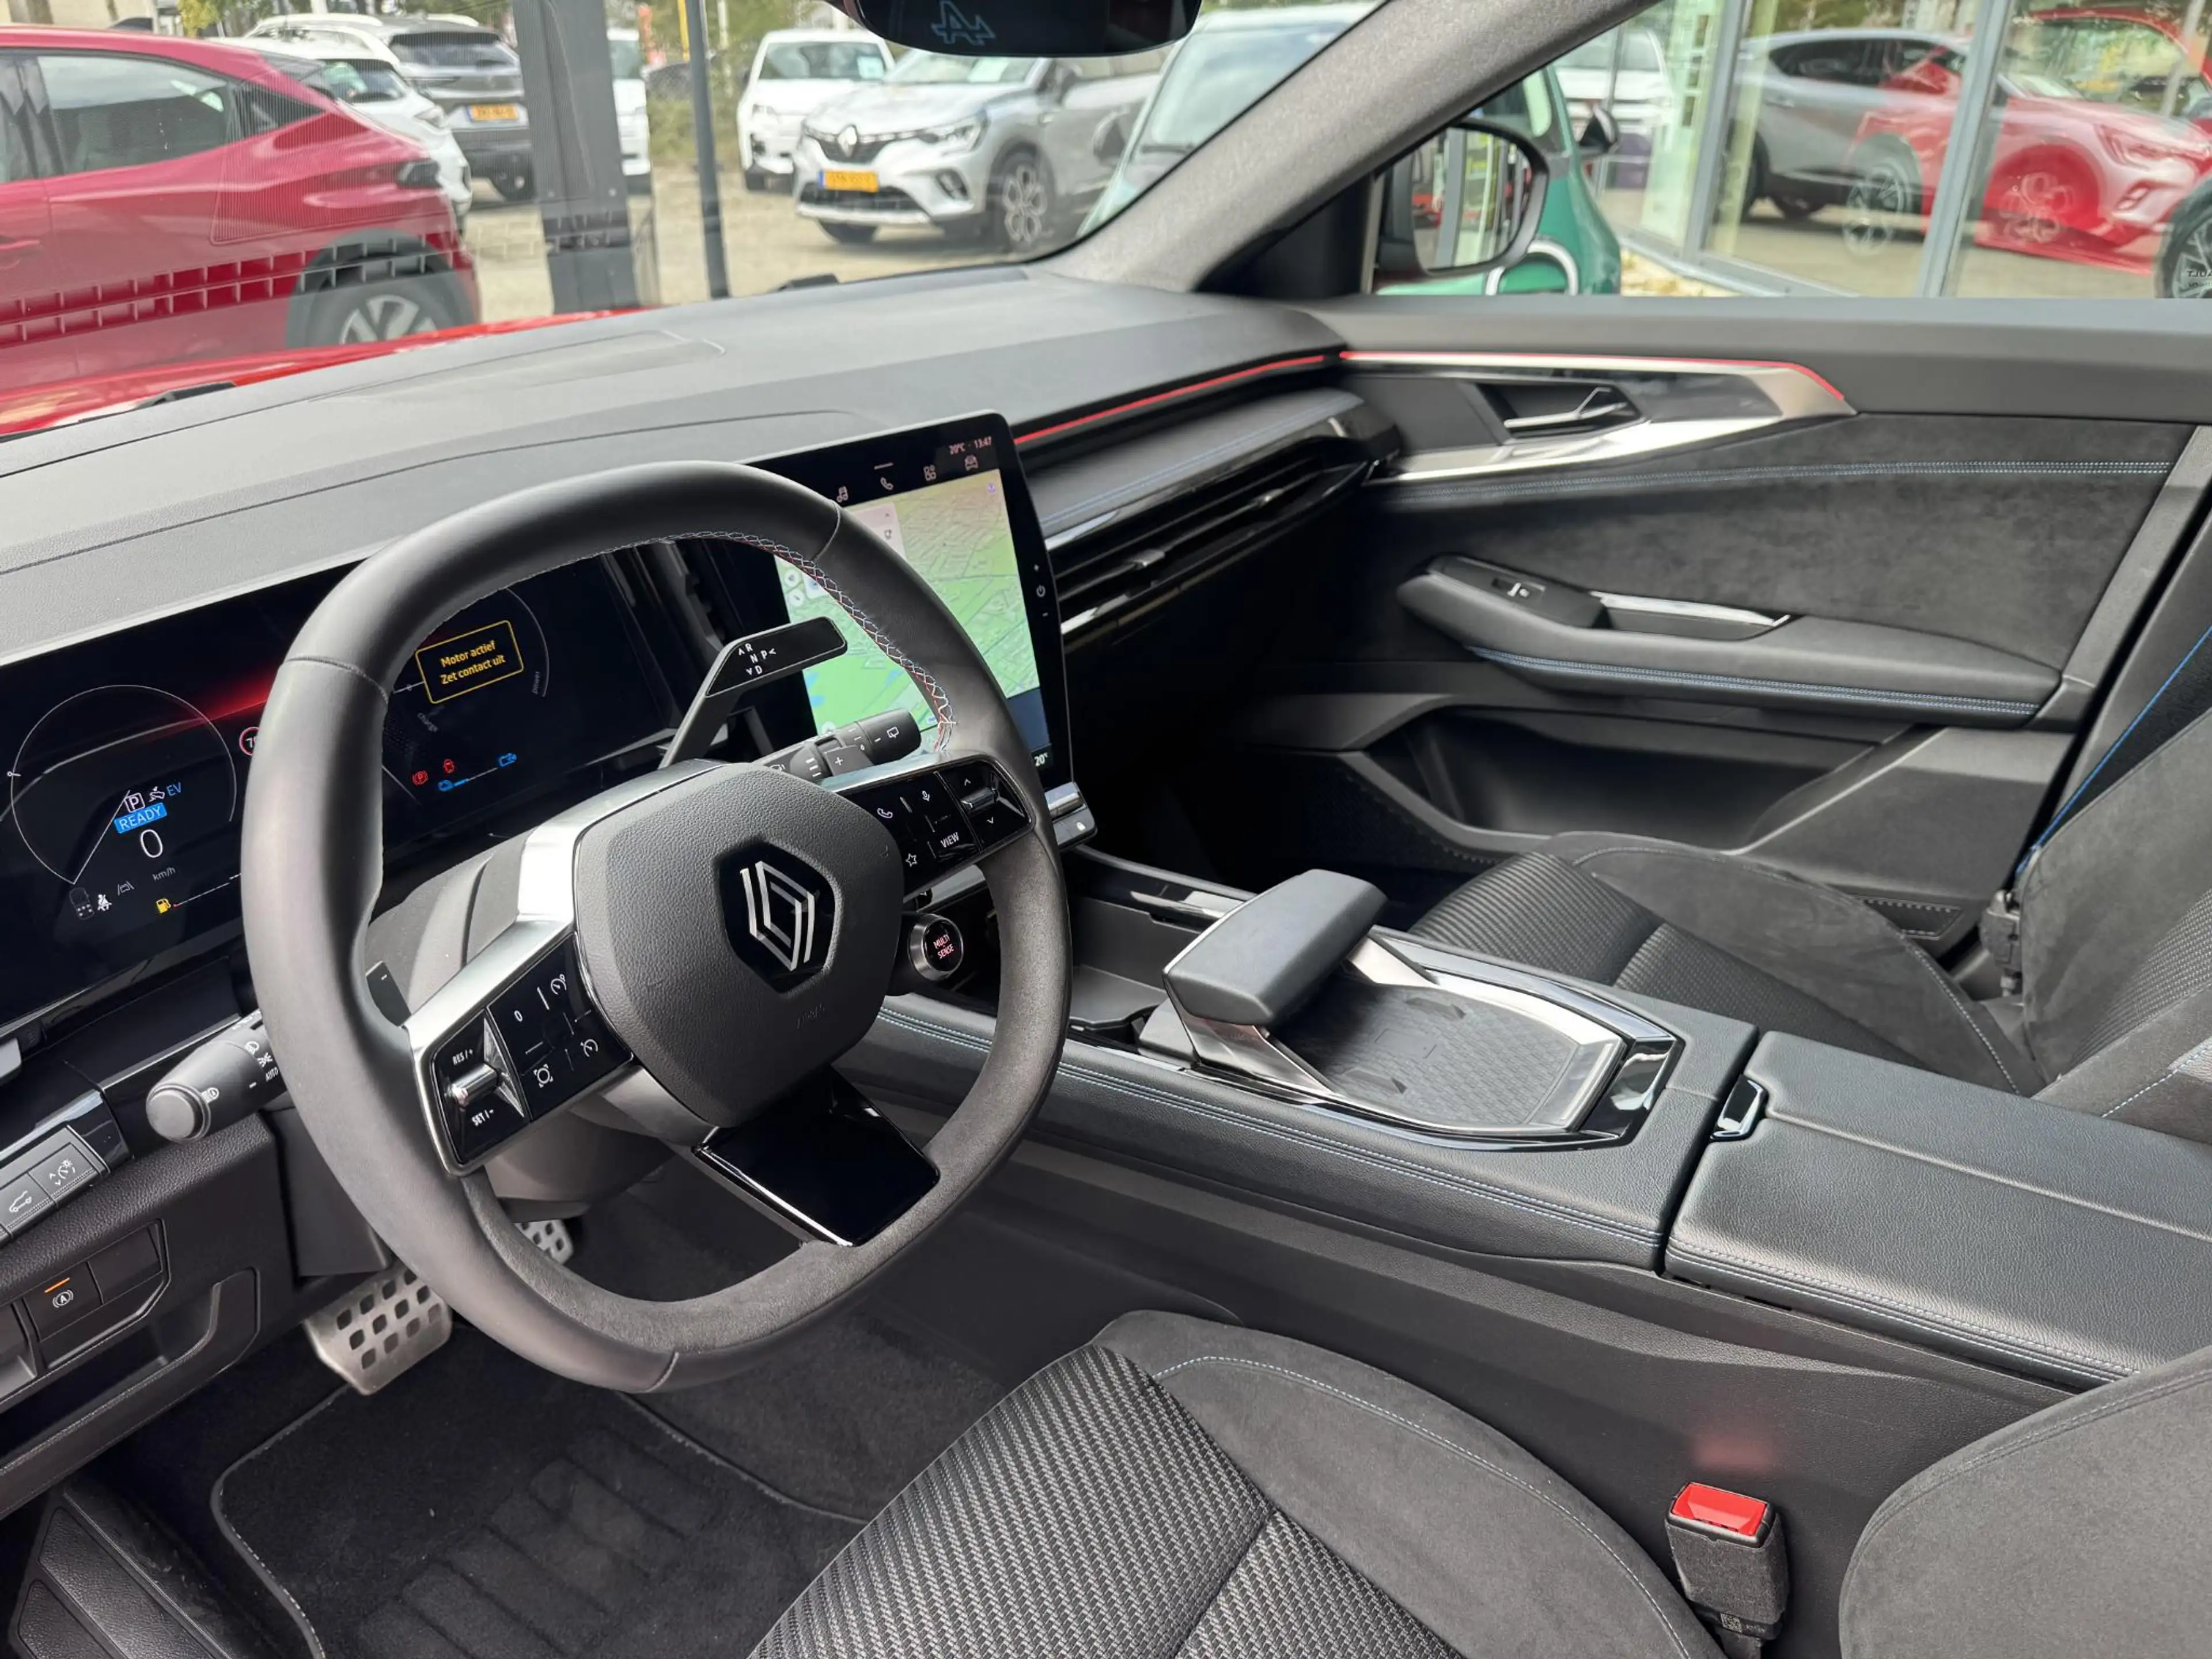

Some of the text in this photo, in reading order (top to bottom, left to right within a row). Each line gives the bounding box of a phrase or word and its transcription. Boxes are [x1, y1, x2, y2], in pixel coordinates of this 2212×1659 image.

[441, 639, 495, 668] Motor actief
[745, 642, 753, 652] R
[749, 650, 767, 664] N P
[440, 654, 506, 684] Zet contact uit
[755, 665, 763, 675] D
[166, 782, 181, 796] EV
[128, 796, 139, 810] P
[119, 805, 162, 830] READY
[140, 829, 164, 858] 0
[940, 831, 959, 848] VIEW
[151, 866, 176, 881] km/h
[933, 934, 950, 949] MULTI
[937, 944, 955, 959] SENSE
[265, 1066, 279, 1082] AUTO
